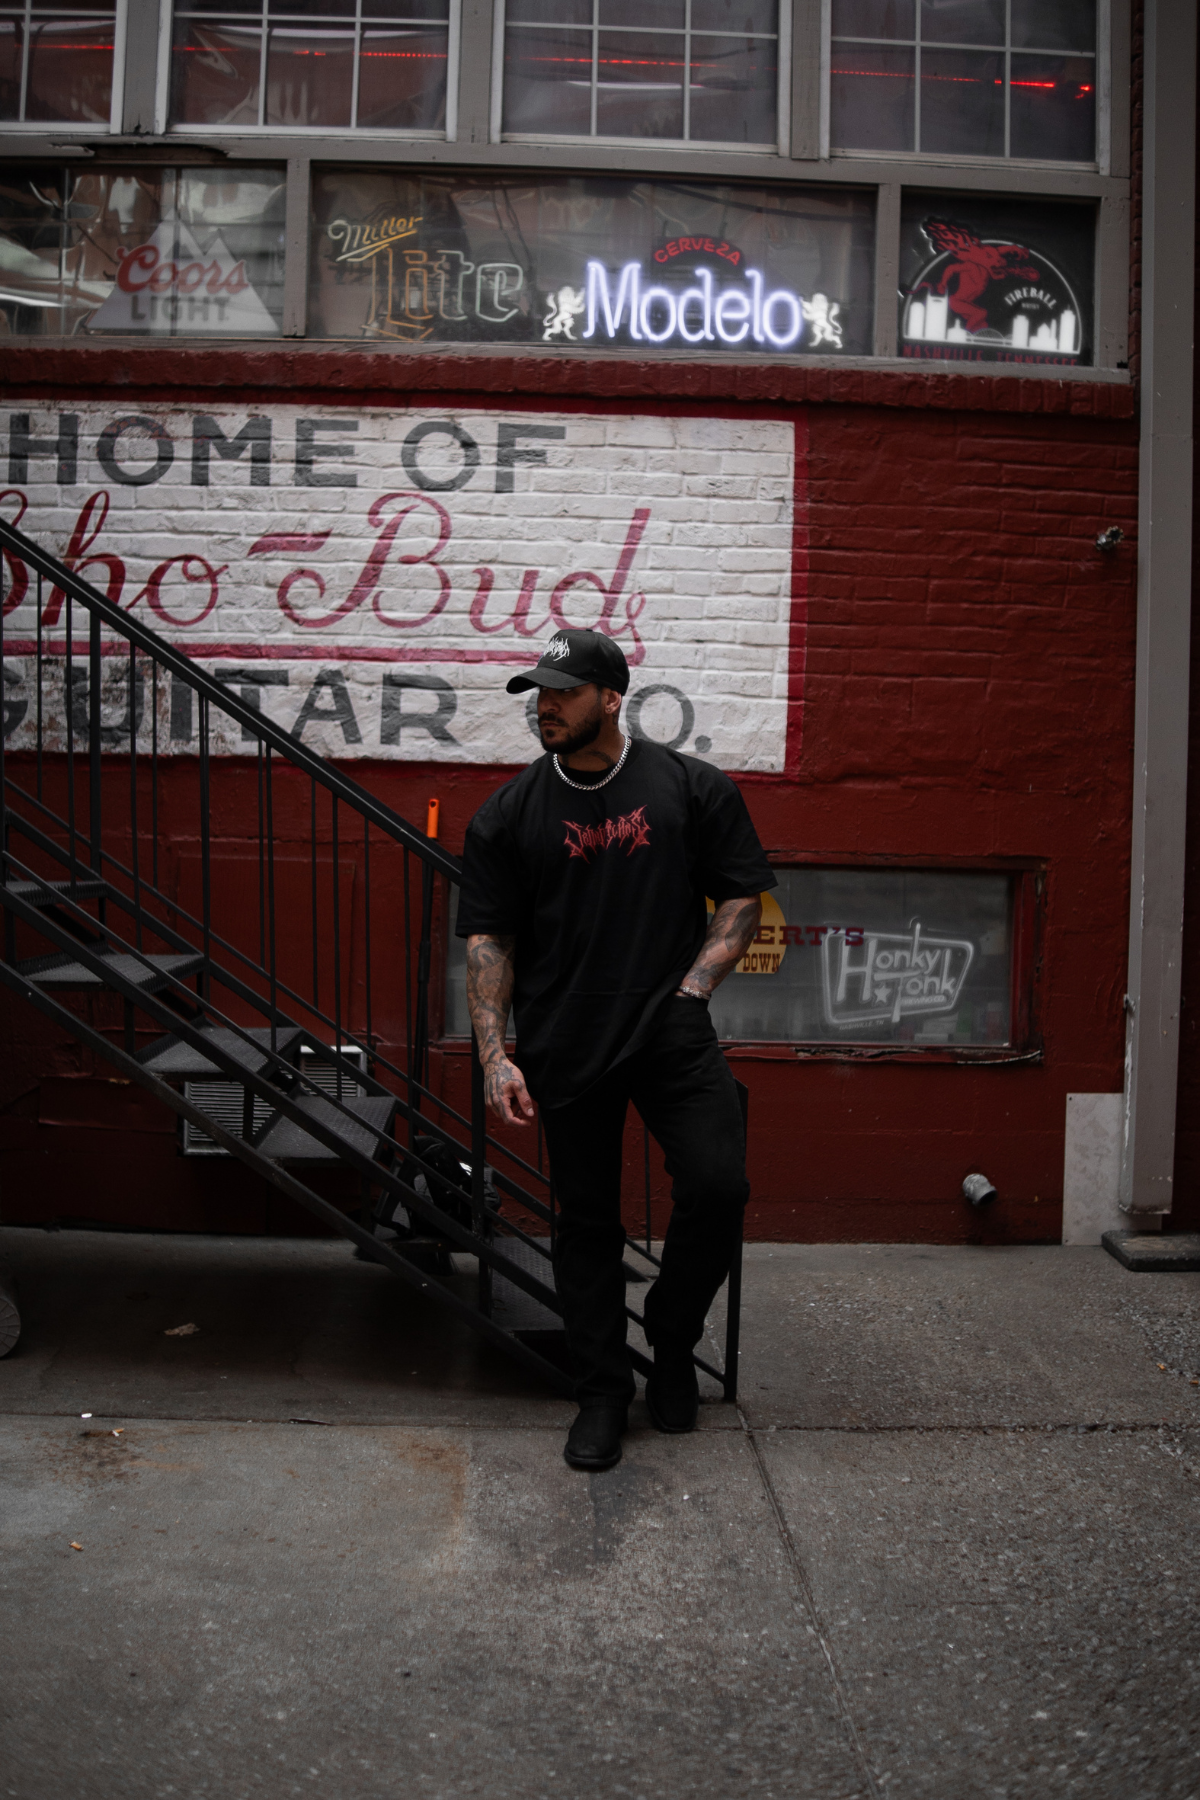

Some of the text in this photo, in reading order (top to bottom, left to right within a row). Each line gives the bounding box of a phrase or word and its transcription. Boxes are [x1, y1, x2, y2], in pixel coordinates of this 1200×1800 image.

[327, 216, 424, 262] Miller
[653, 237, 742, 266] CERVEZA
[116, 244, 250, 294] Coors
[130, 294, 230, 321] LIGHT
[362, 248, 524, 342] Lite
[582, 261, 802, 345] Modelo
[1004, 286, 1057, 310] FIREBALL
[8, 413, 567, 494] HOME OF
[525, 683, 713, 753] O.
[752, 925, 865, 947] ERT'S
[742, 953, 781, 973] DOWN
[836, 922, 942, 1002] Honky
[873, 949, 956, 1023] Tonk
